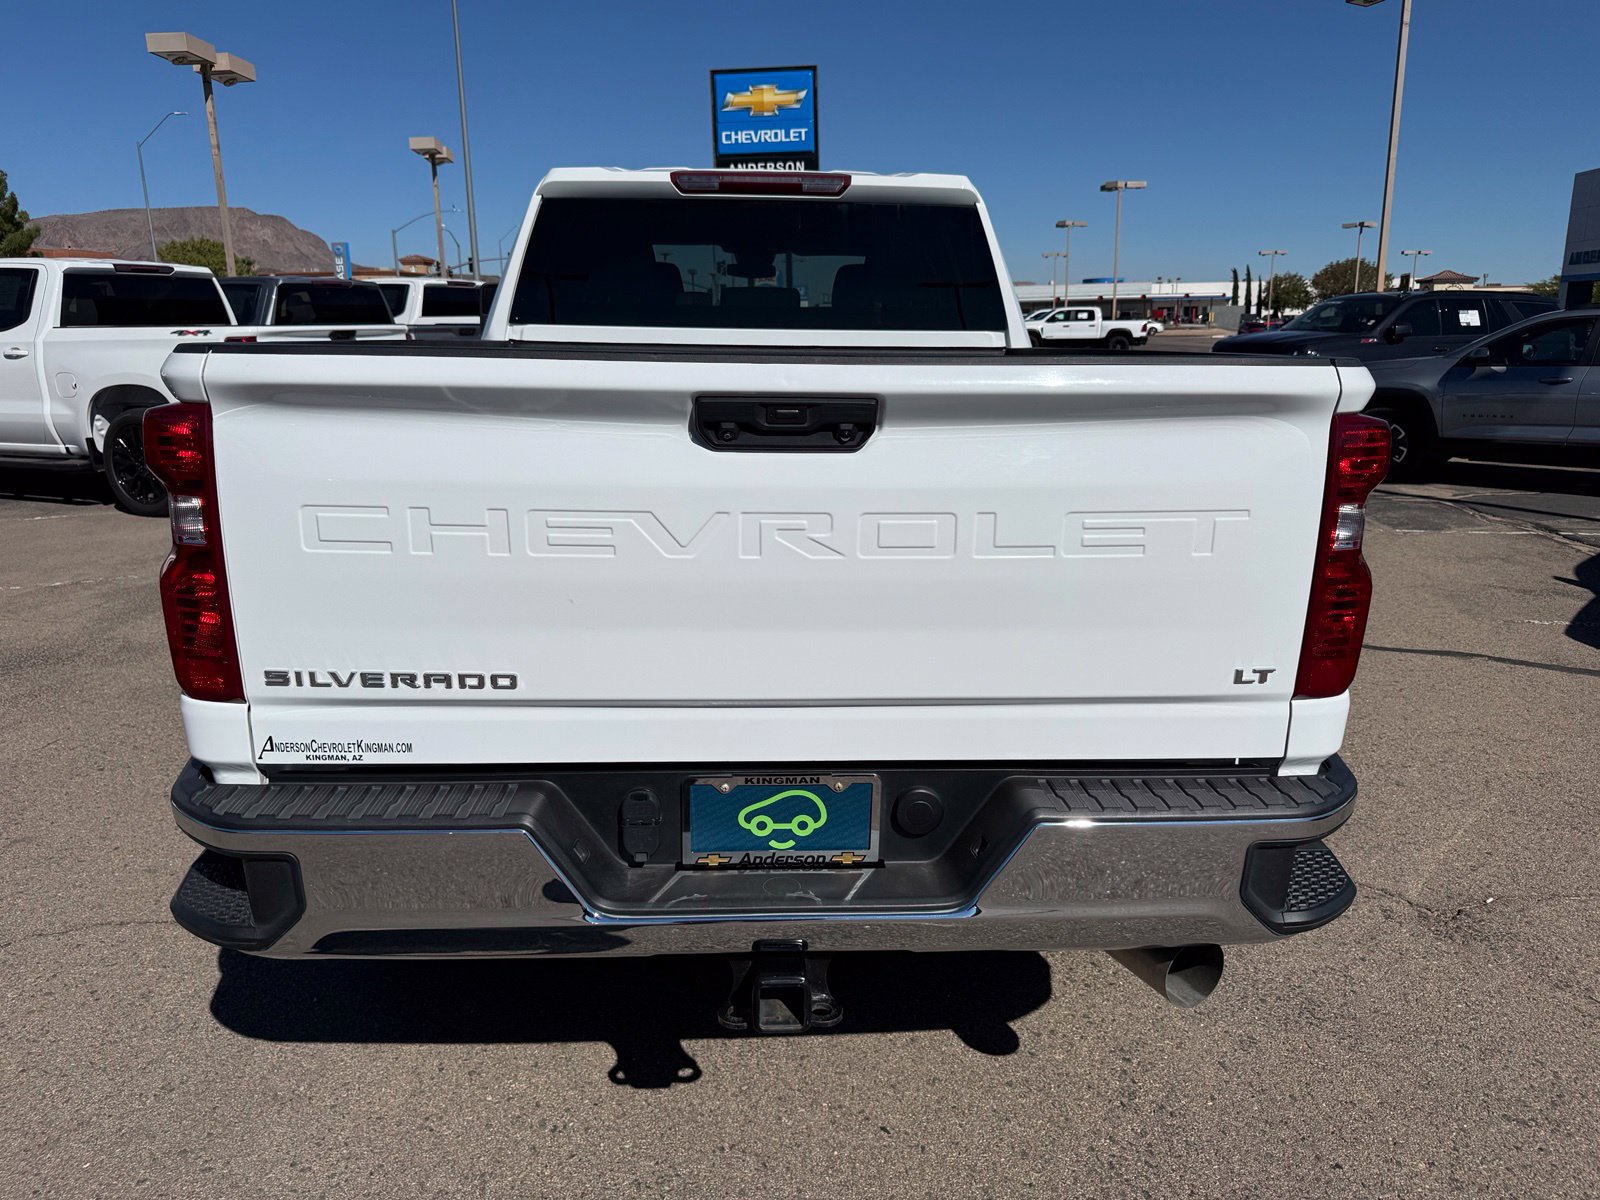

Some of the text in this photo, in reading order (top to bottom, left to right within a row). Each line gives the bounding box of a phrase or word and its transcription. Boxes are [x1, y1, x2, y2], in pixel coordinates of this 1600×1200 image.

[721, 128, 808, 144] CHEVROLET
[729, 161, 805, 171] ANDERSON
[299, 504, 1250, 559] CHEVROLET
[263, 670, 519, 690] SILVERADO
[1233, 668, 1277, 685] LT
[305, 754, 350, 762] KINGMAN,
[744, 776, 821, 785] KINGMAN
[738, 852, 827, 867] Anderson
